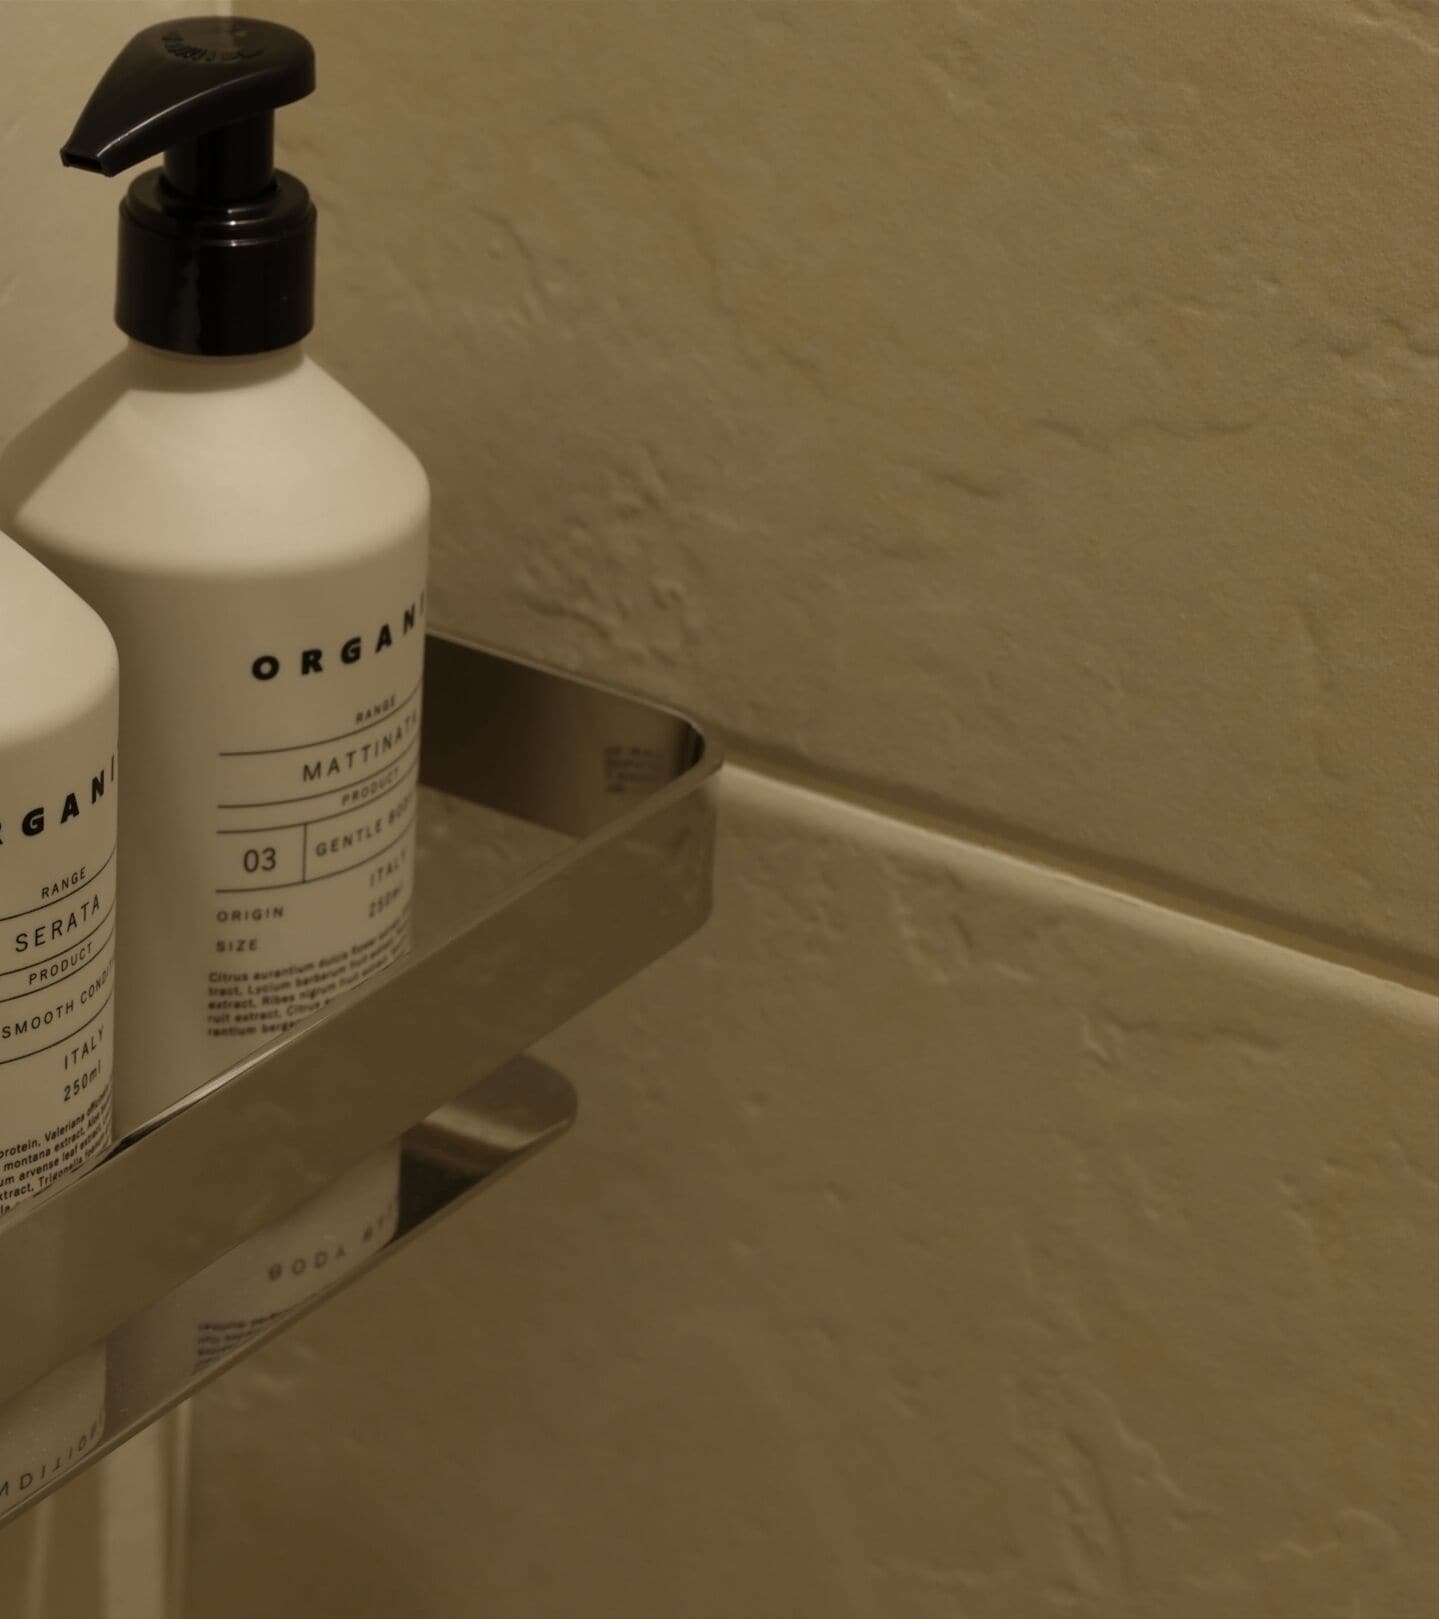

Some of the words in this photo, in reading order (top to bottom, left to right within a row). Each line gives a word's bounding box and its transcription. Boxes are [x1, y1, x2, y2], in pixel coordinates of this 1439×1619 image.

[355, 694, 396, 724] RANGE
[341, 767, 399, 806] PRODUCT
[315, 818, 383, 857] GENTLE
[242, 847, 277, 872] 03
[41, 866, 86, 899] RANGE
[16, 894, 100, 953] SERATA
[216, 906, 284, 923] ORIGIN
[28, 942, 93, 986] PRODUCT
[216, 939, 258, 953] SIZE
[1, 1000, 74, 1039] SMOOTH
[64, 1025, 103, 1070] ITALY
[64, 1059, 101, 1101] 250ml
[3, 1149, 51, 1171] montana
[18, 1158, 59, 1182] arvense
[62, 1144, 79, 1162] leaf
